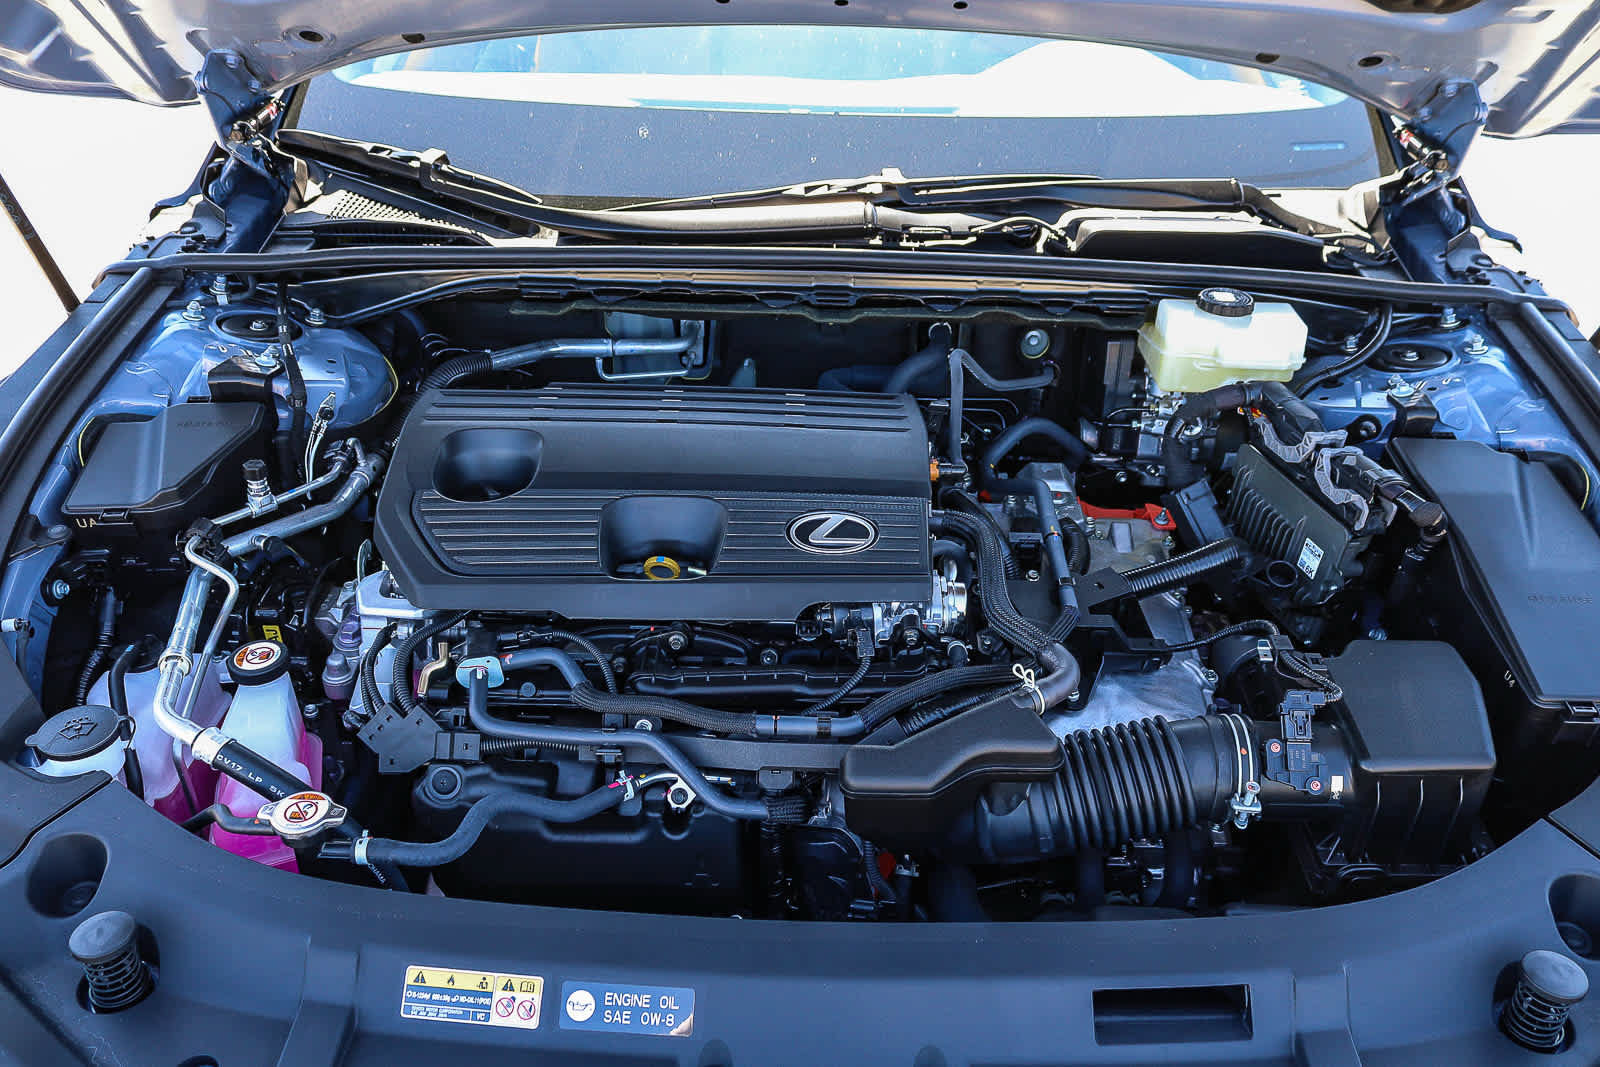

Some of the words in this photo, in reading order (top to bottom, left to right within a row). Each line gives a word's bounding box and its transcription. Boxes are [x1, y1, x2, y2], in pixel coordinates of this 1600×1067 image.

[604, 992, 651, 1008] ENGINE
[659, 995, 680, 1010] OIL
[603, 1010, 632, 1025] SAE
